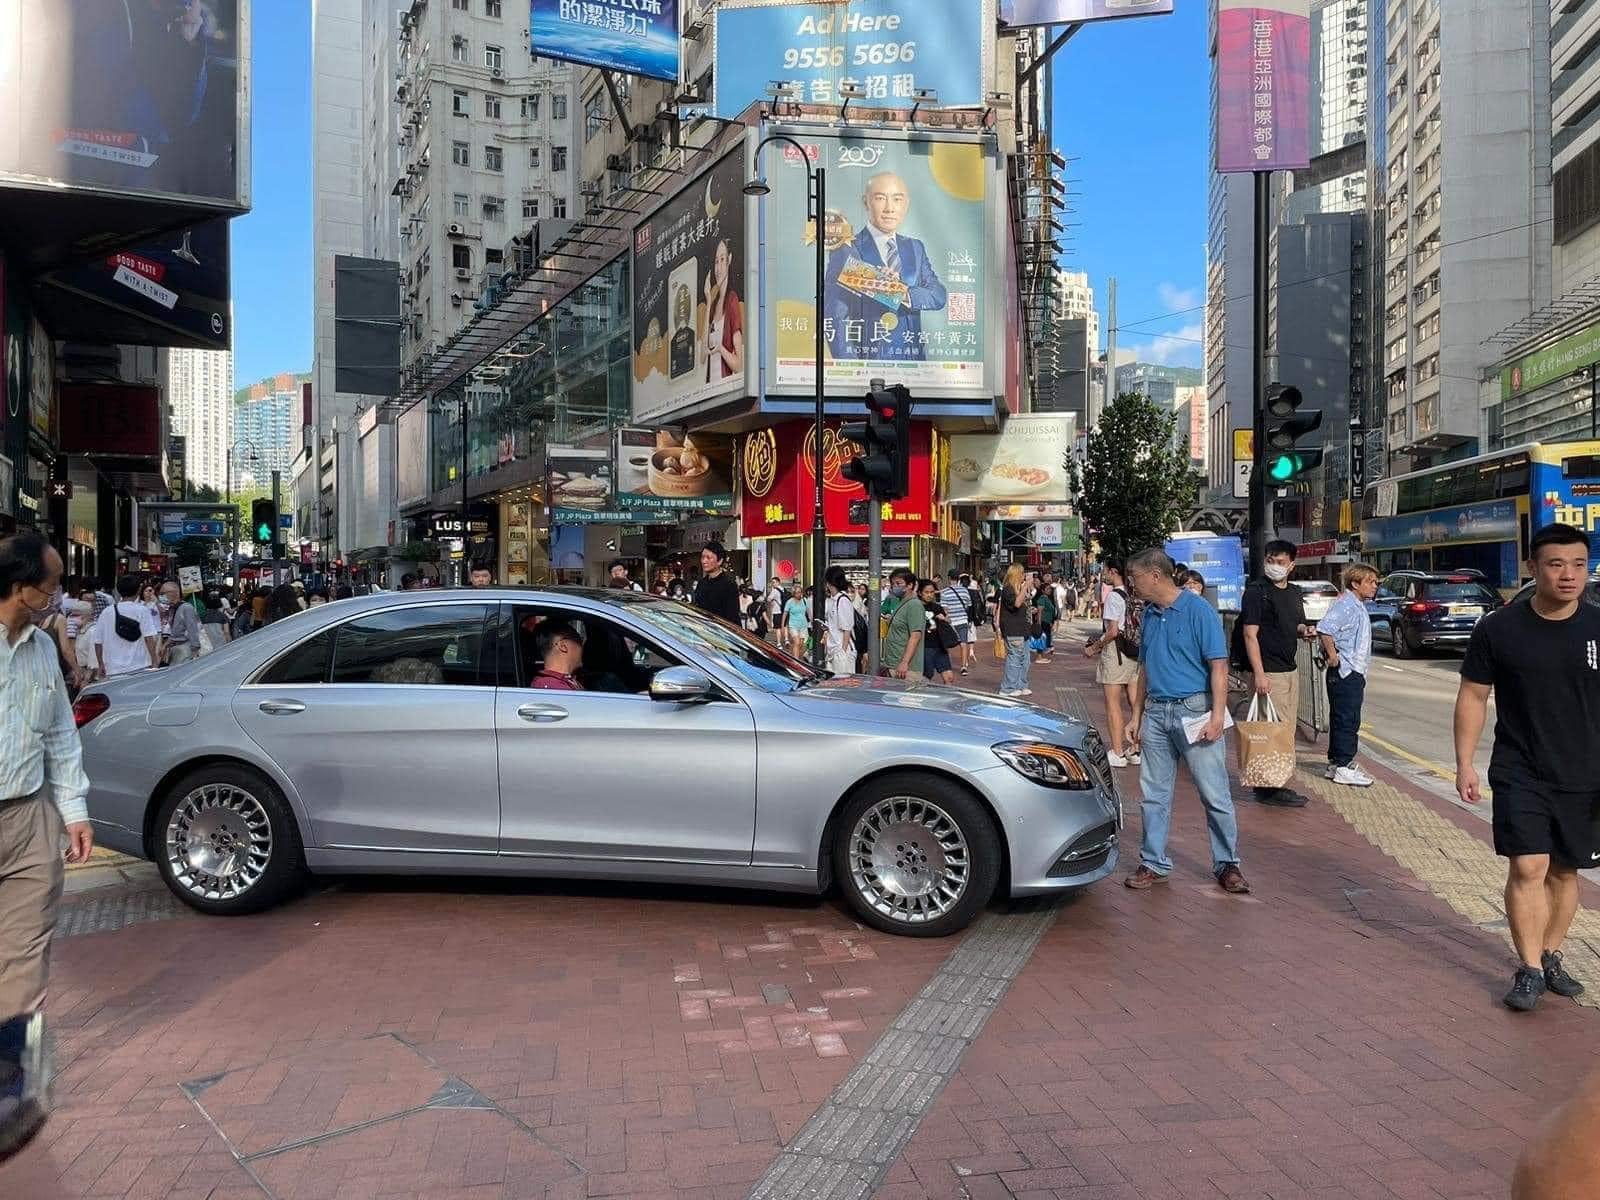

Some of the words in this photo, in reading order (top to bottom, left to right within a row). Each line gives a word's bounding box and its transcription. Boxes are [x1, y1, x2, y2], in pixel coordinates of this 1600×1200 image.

[797, 15, 830, 35] Ad
[840, 14, 901, 33] Here
[783, 45, 844, 69] 9556
[853, 41, 916, 66] 5696
[1253, 19, 1272, 160] 香港亞洲國際都會
[117, 254, 135, 268] GOOD
[138, 261, 157, 276] TASTE
[780, 317, 809, 331] 我信
[813, 318, 893, 343] 馬百良
[622, 499, 632, 507] 1/F
[633, 499, 642, 507] JP
[643, 499, 660, 507] Plaza
